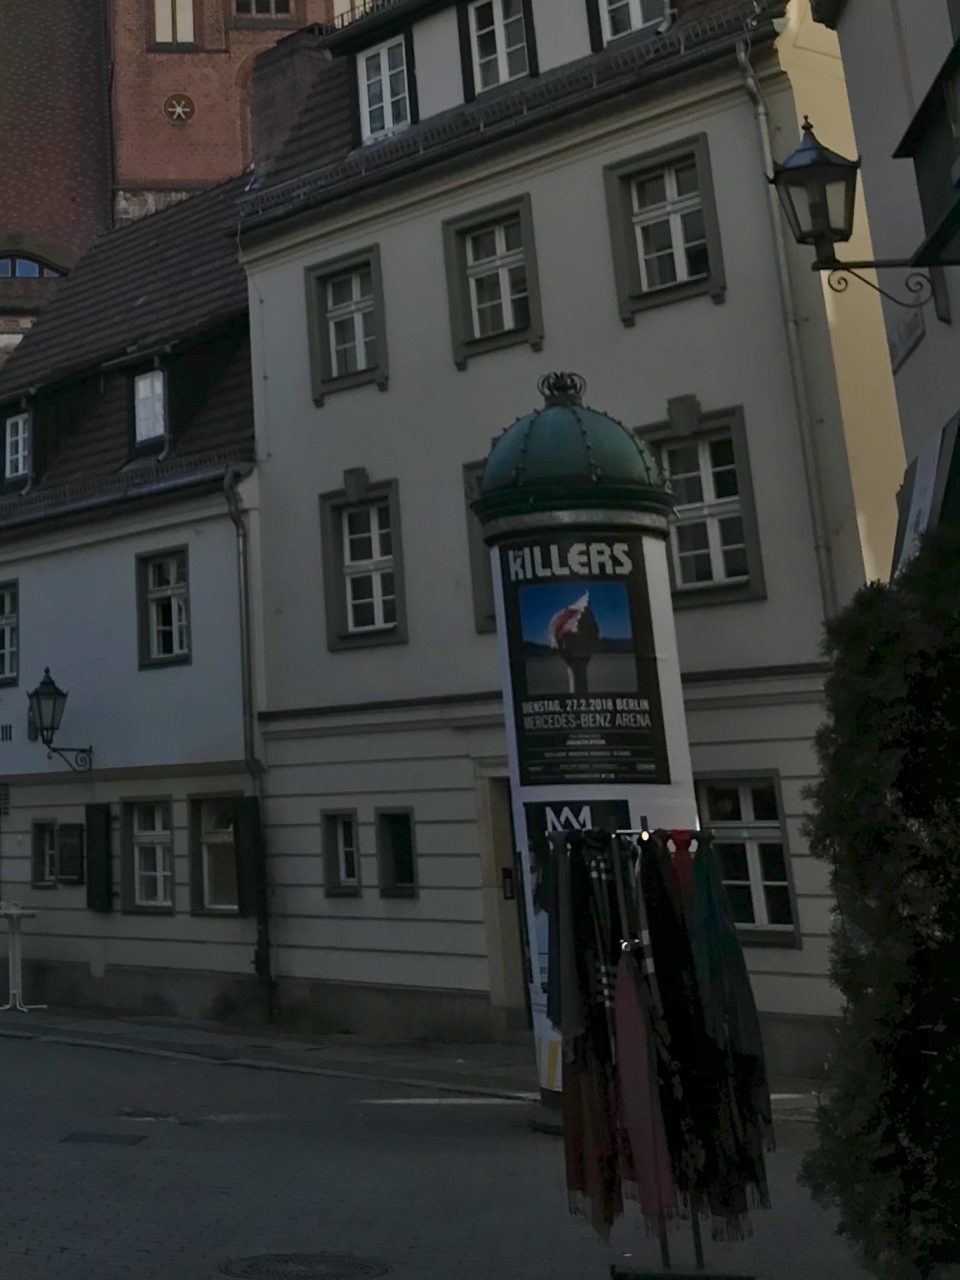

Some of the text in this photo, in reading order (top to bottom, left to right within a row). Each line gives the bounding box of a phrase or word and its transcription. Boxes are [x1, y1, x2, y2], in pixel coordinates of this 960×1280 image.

[508, 542, 633, 581] KILLERS
[616, 697, 650, 711] BERLIN
[615, 711, 652, 728] ARENA
